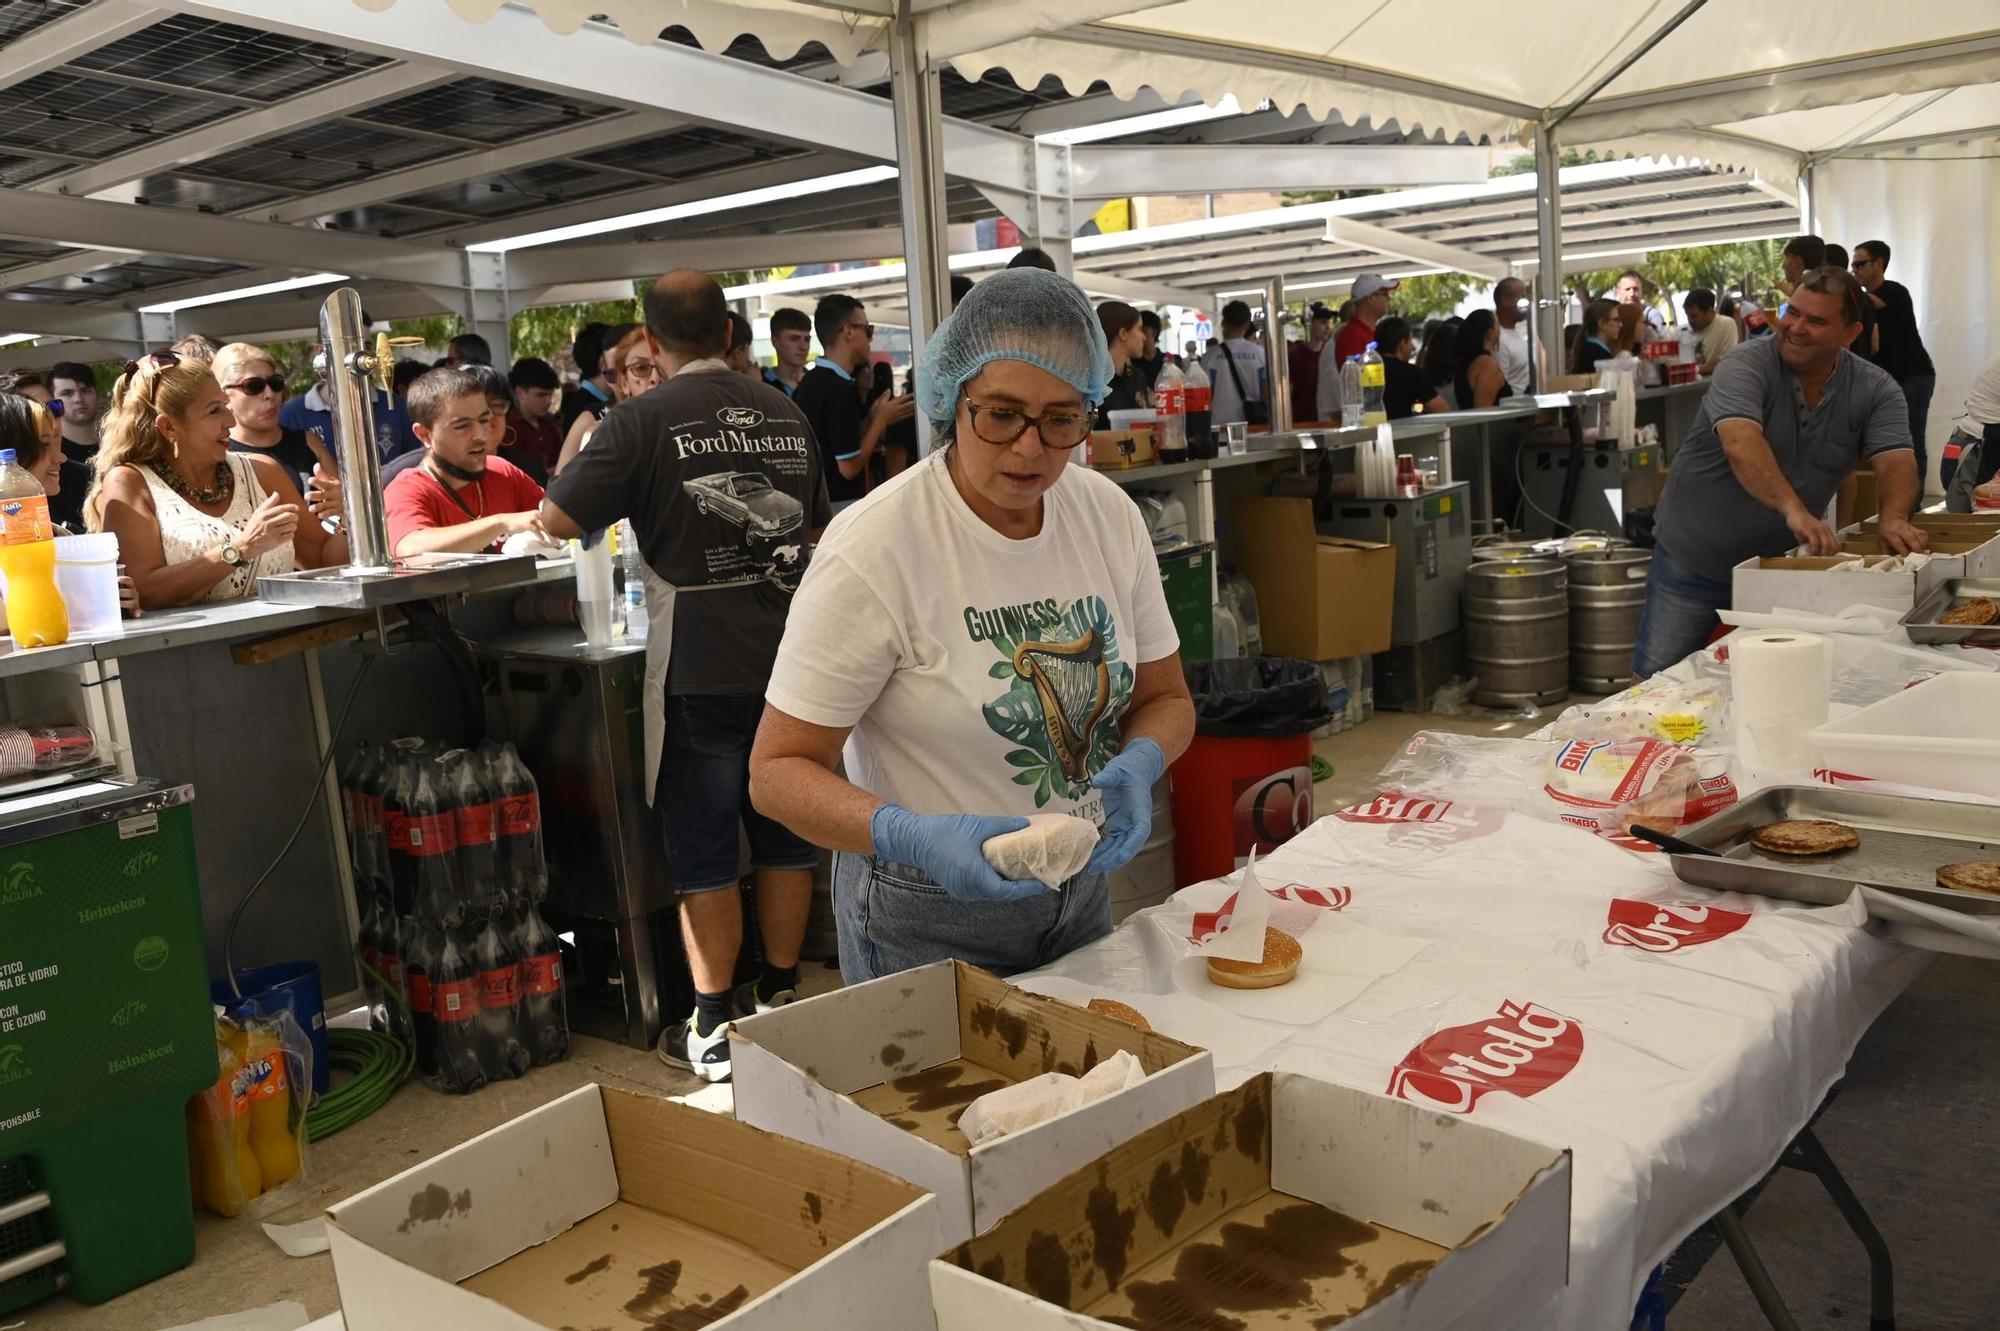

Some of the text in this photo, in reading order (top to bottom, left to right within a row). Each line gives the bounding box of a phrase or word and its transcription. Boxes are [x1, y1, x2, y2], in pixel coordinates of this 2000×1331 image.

[726, 410, 755, 426] Ford
[727, 430, 808, 457] Mustang
[1, 501, 23, 512] FANTA
[963, 598, 1061, 643] GUINNESS
[1700, 776, 1729, 790] BIMBO
[78, 897, 147, 923] Heineken
[15, 973, 28, 987] DE
[28, 965, 58, 982] VIDRIO
[0, 1004, 19, 1019] CON
[2, 1010, 46, 1033] DE OZONO
[108, 1042, 173, 1074] Heineken
[0, 1108, 41, 1131] PONSABLE
